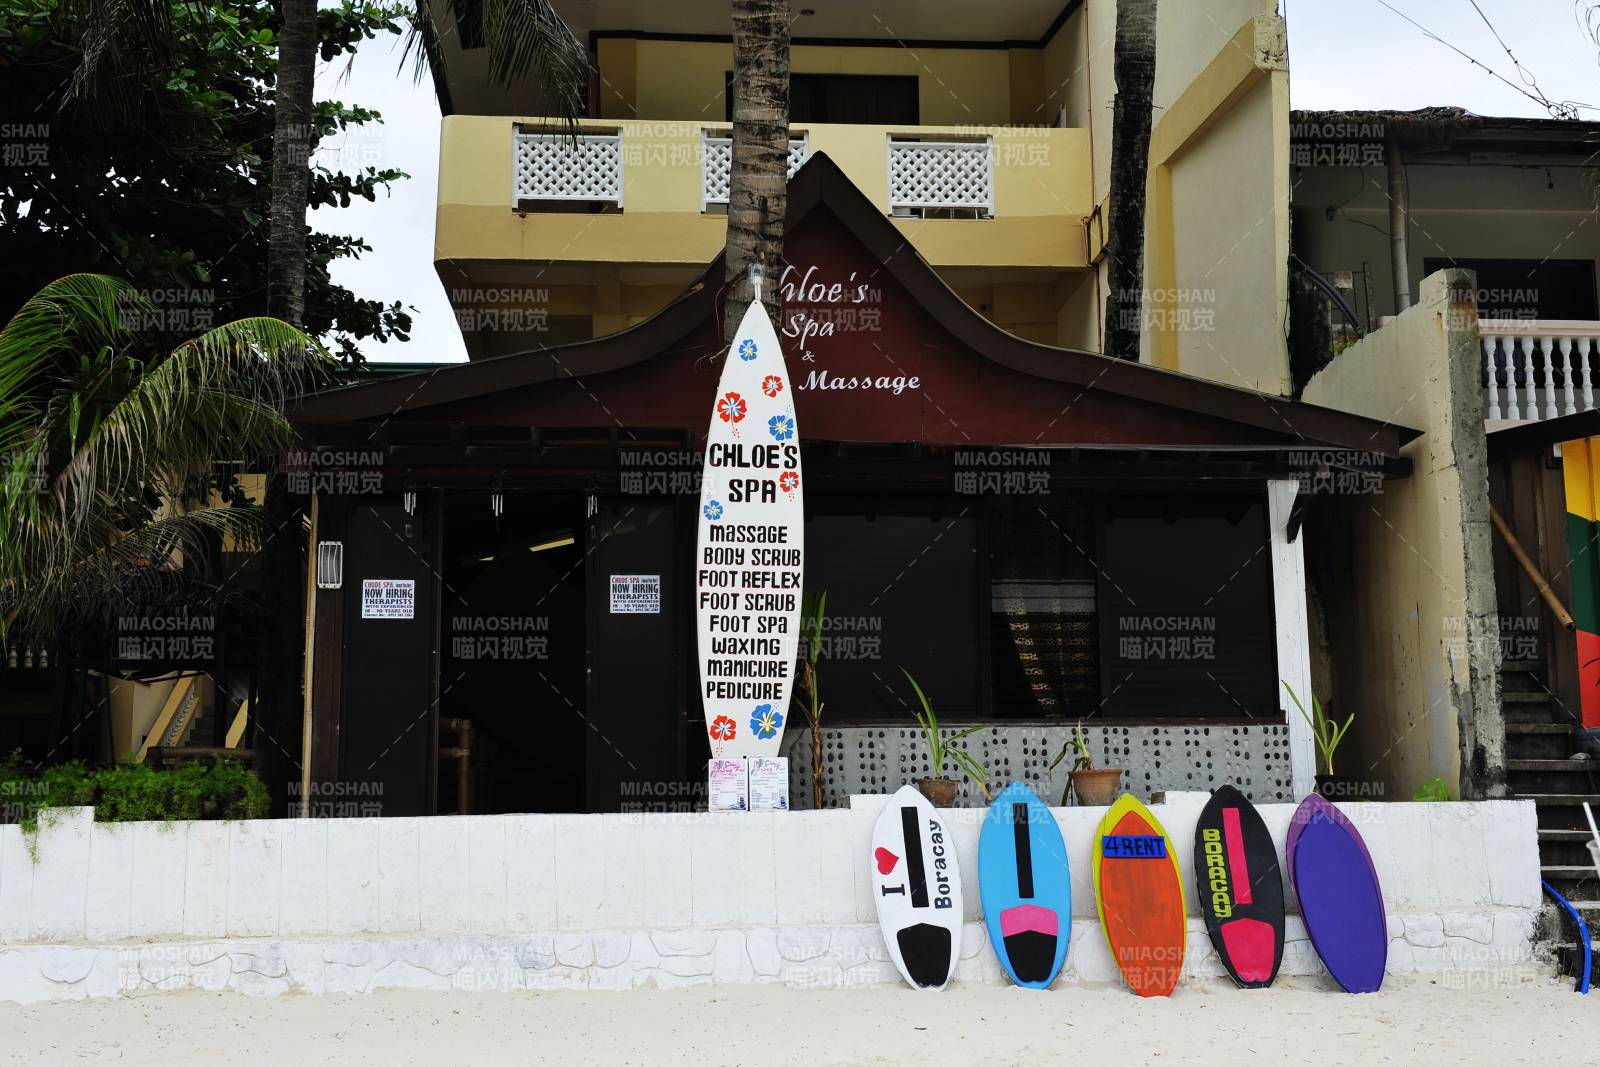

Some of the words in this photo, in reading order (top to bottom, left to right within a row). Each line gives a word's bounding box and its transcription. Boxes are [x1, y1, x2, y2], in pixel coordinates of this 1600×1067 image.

[780, 264, 869, 304] hloe's
[781, 313, 834, 351] Spa
[801, 350, 815, 363] &
[798, 370, 921, 395] Massage
[709, 442, 798, 469] CHLOE'S
[728, 479, 777, 503] SPA
[751, 548, 801, 567] SCRUB
[612, 584, 630, 593] NOW
[632, 584, 659, 593] HIRING
[699, 570, 738, 587] FOOT
[741, 571, 801, 589] REFLEX
[364, 588, 383, 598] NOW
[385, 588, 413, 598] HIRING
[700, 592, 740, 610] FOOT
[744, 593, 795, 612] SCRUB
[709, 615, 751, 633] FOOT
[706, 681, 783, 700] PEDICURE
[929, 819, 953, 909] Boracay
[1202, 828, 1233, 918] BORACAY
[881, 883, 906, 897] I
